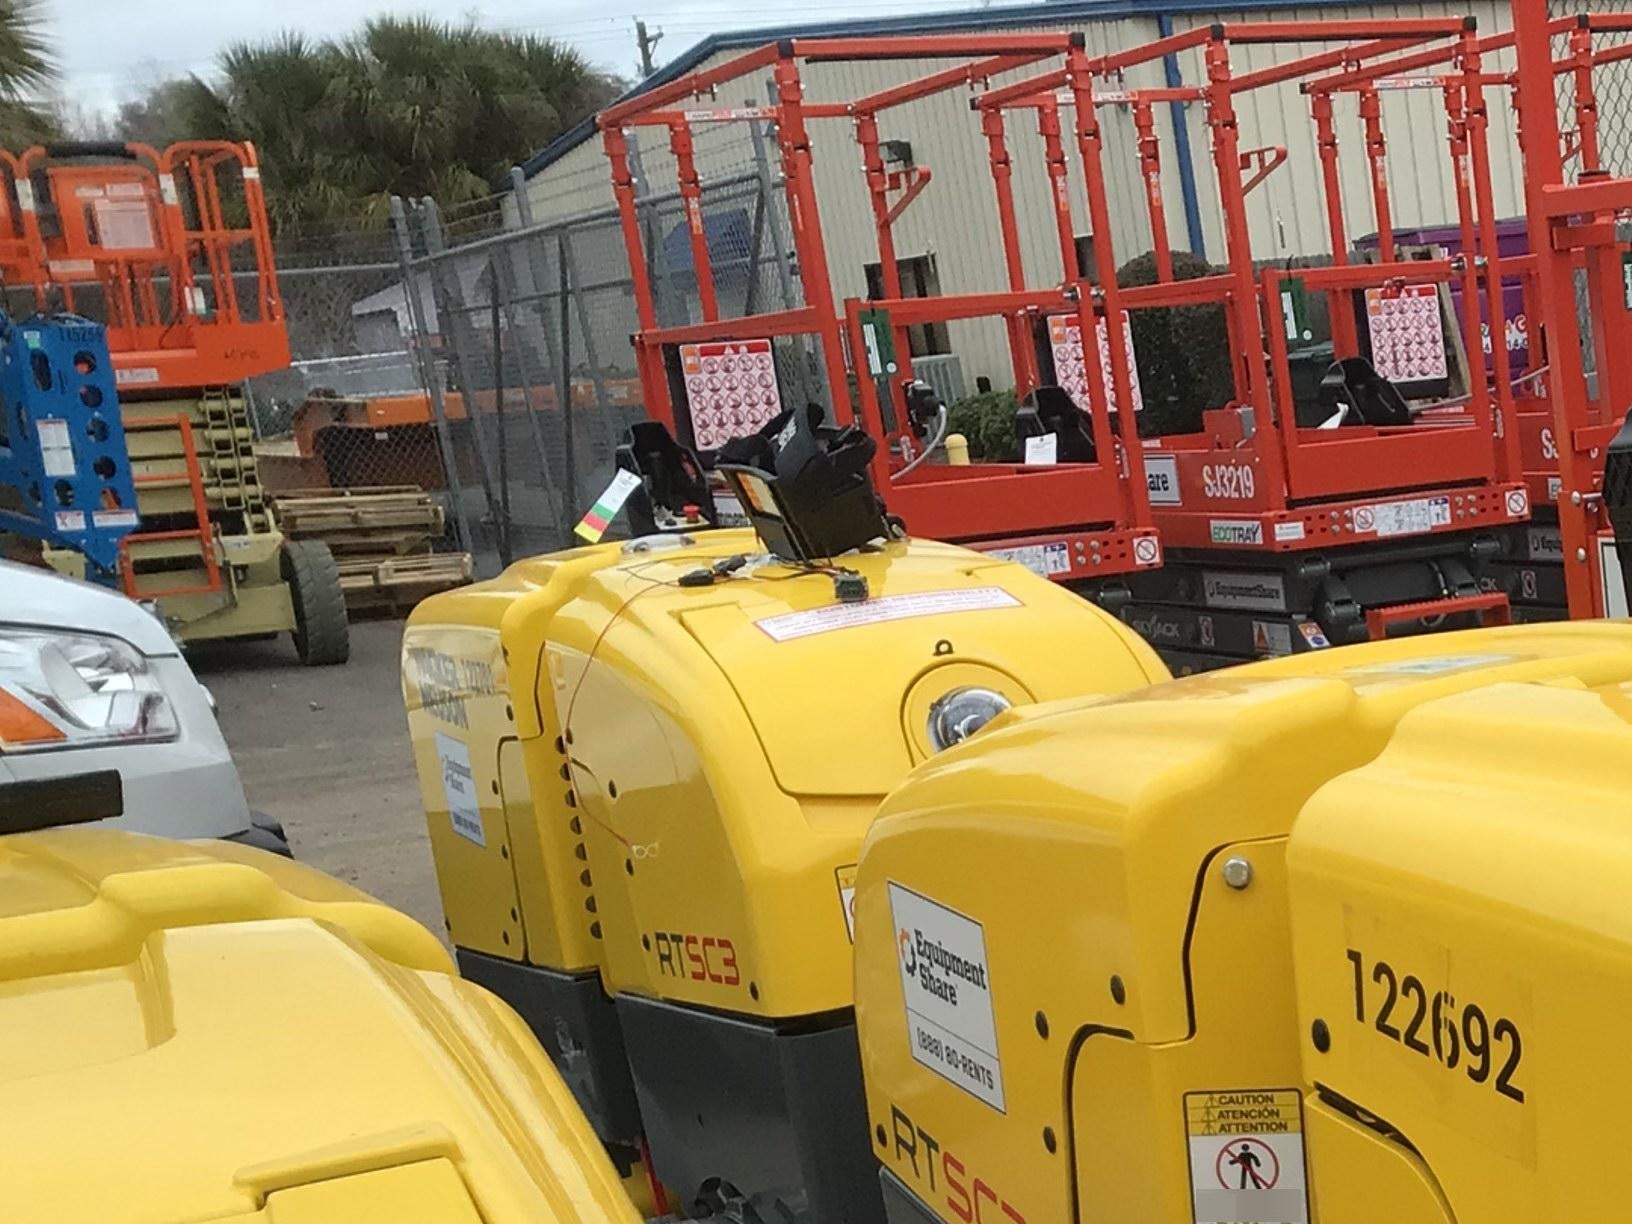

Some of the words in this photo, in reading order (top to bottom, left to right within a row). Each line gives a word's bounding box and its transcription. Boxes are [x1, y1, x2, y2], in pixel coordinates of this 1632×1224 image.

[1202, 464, 1255, 499] SJ3219
[1212, 524, 1260, 543] ECOTRAY
[914, 928, 987, 990] Equipment
[919, 960, 958, 1007] Share
[1346, 947, 1525, 1105] 122692
[916, 1025, 945, 1062] (888)
[944, 1044, 995, 1091] 80-RENTS
[1217, 1108, 1281, 1120] ATENCIÓN
[1218, 1094, 1275, 1106] CAUTION
[1218, 1121, 1289, 1133] ATTENTION
